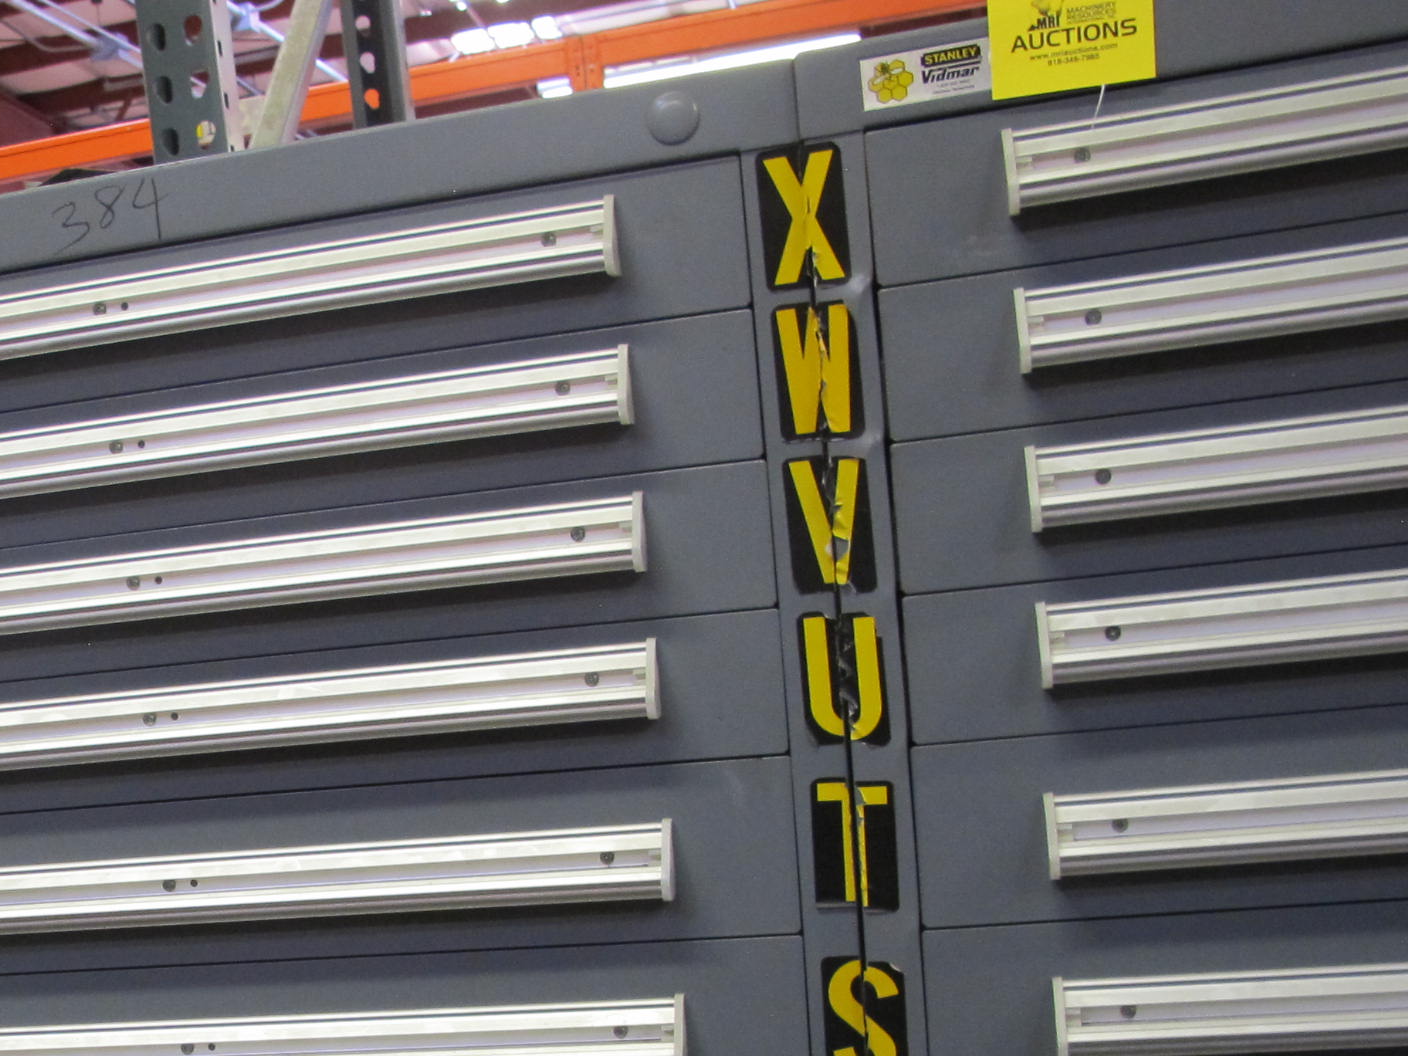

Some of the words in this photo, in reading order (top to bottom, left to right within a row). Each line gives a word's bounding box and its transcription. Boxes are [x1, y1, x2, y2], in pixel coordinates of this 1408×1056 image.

[921, 66, 980, 84] Vidmar
[924, 47, 977, 64] STANLEY
[1010, 18, 1138, 53] AUCTIONS
[52, 177, 170, 256] 384
[762, 149, 846, 286] X
[775, 303, 852, 435] W
[788, 459, 860, 585] V
[803, 616, 883, 742] U
[816, 782, 889, 908] T
